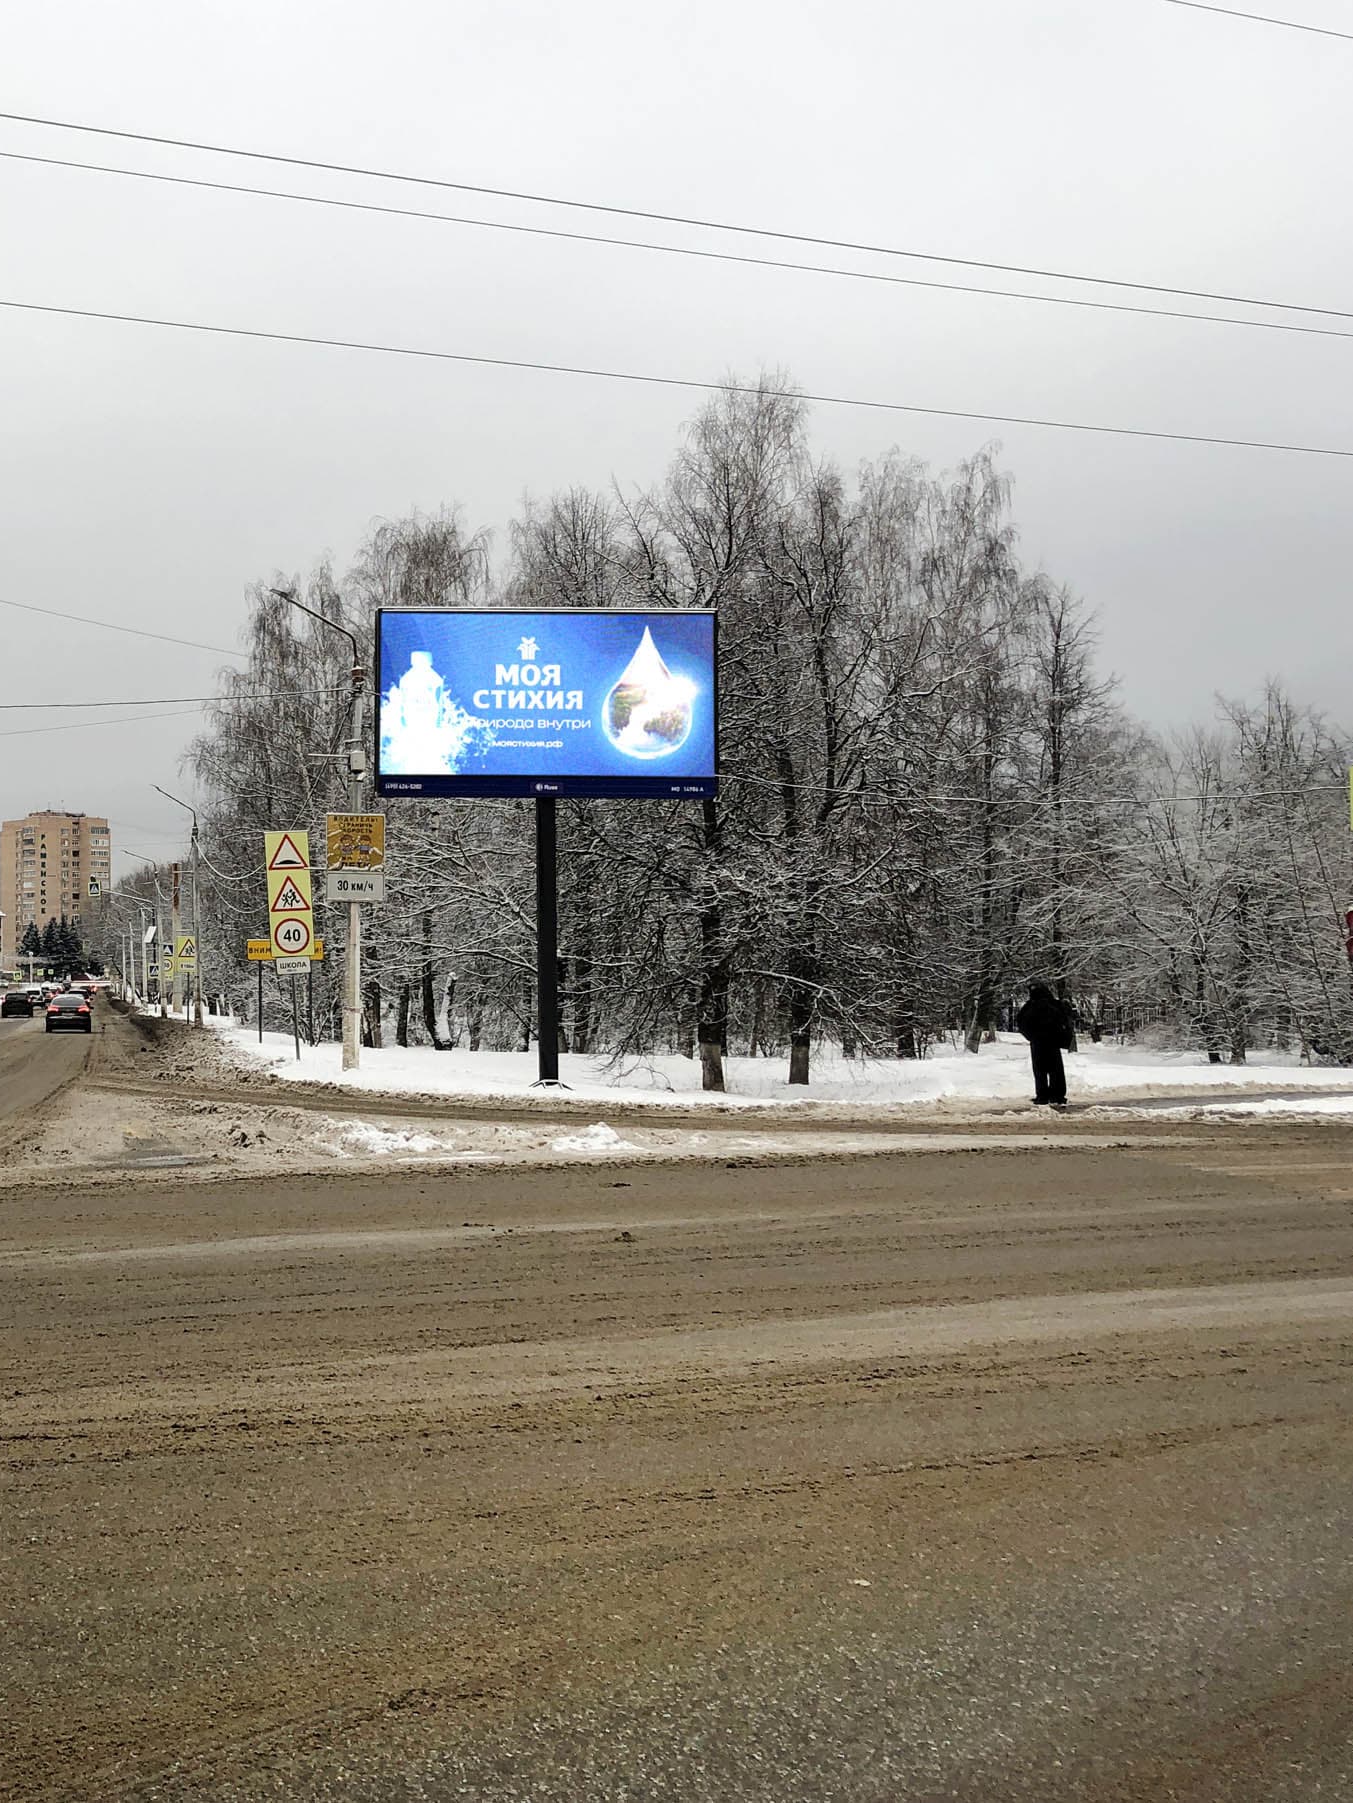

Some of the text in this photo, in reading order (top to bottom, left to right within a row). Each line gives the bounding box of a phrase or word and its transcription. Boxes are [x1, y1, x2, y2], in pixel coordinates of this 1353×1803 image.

[495, 664, 561, 686] МОЯ
[472, 689, 583, 710] СТИХИЯ
[537, 719, 591, 730] внутри
[337, 880, 374, 892] 30 км/ч
[283, 929, 301, 942] 40
[279, 961, 308, 969] ШКОЛА
